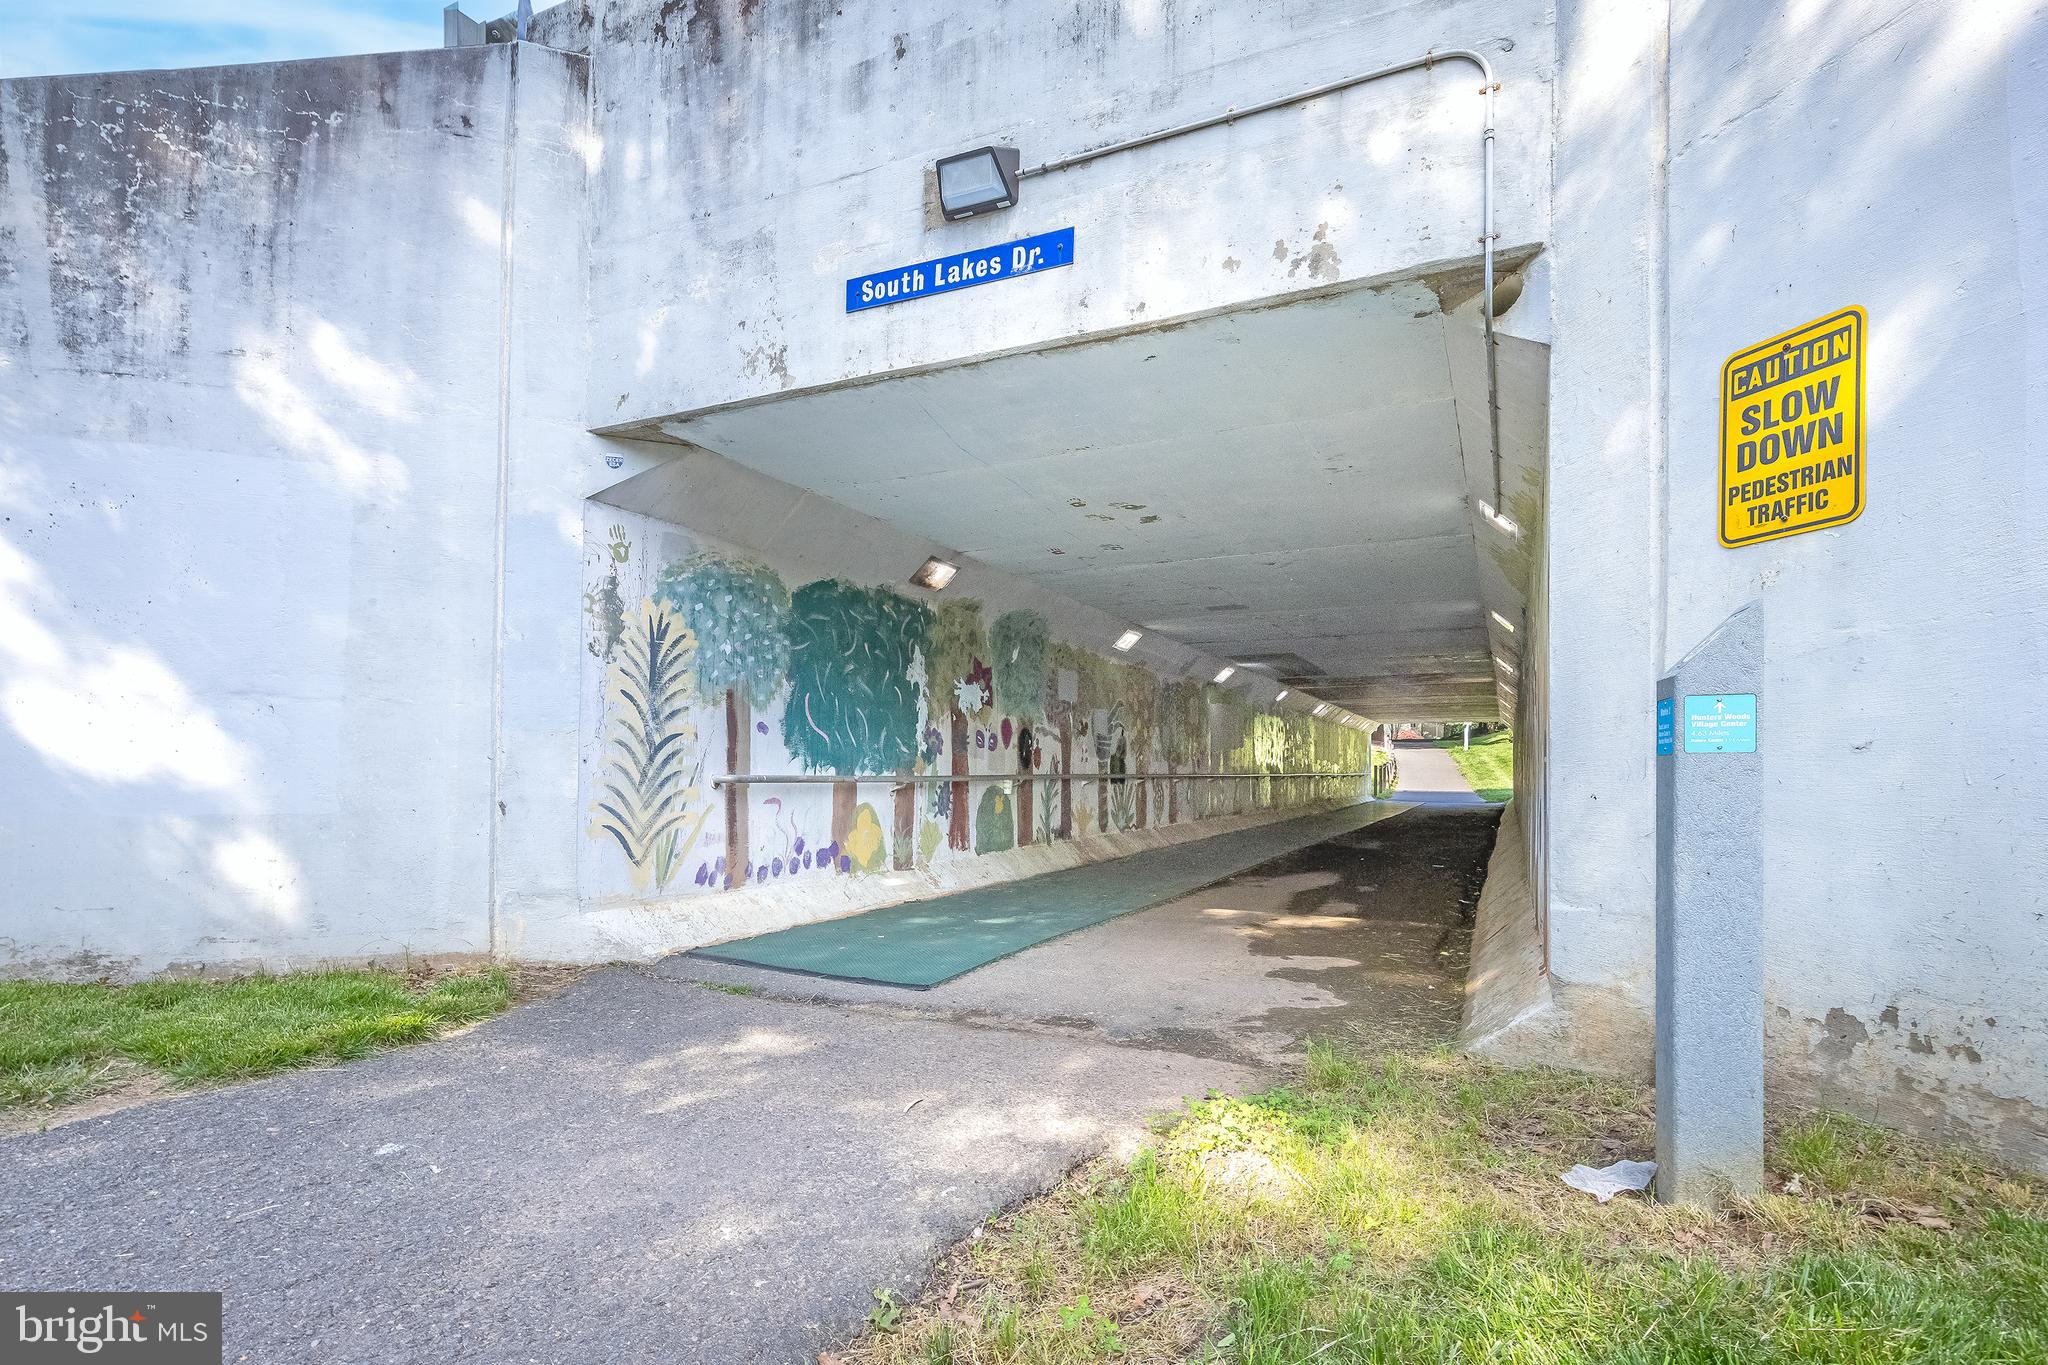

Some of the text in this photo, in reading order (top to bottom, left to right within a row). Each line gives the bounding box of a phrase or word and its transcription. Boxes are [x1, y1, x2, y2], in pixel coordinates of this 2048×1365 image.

[861, 245, 1045, 303] South Lakes Dr.
[1733, 330, 1849, 396] CAUTION
[1740, 374, 1841, 437] SLOW
[1736, 411, 1844, 473] DOWN
[1728, 454, 1853, 506] PEDESTRIAN
[1747, 488, 1829, 527] TRAFFIC
[1691, 721, 1719, 729] Village
[1724, 712, 1751, 720] Woods
